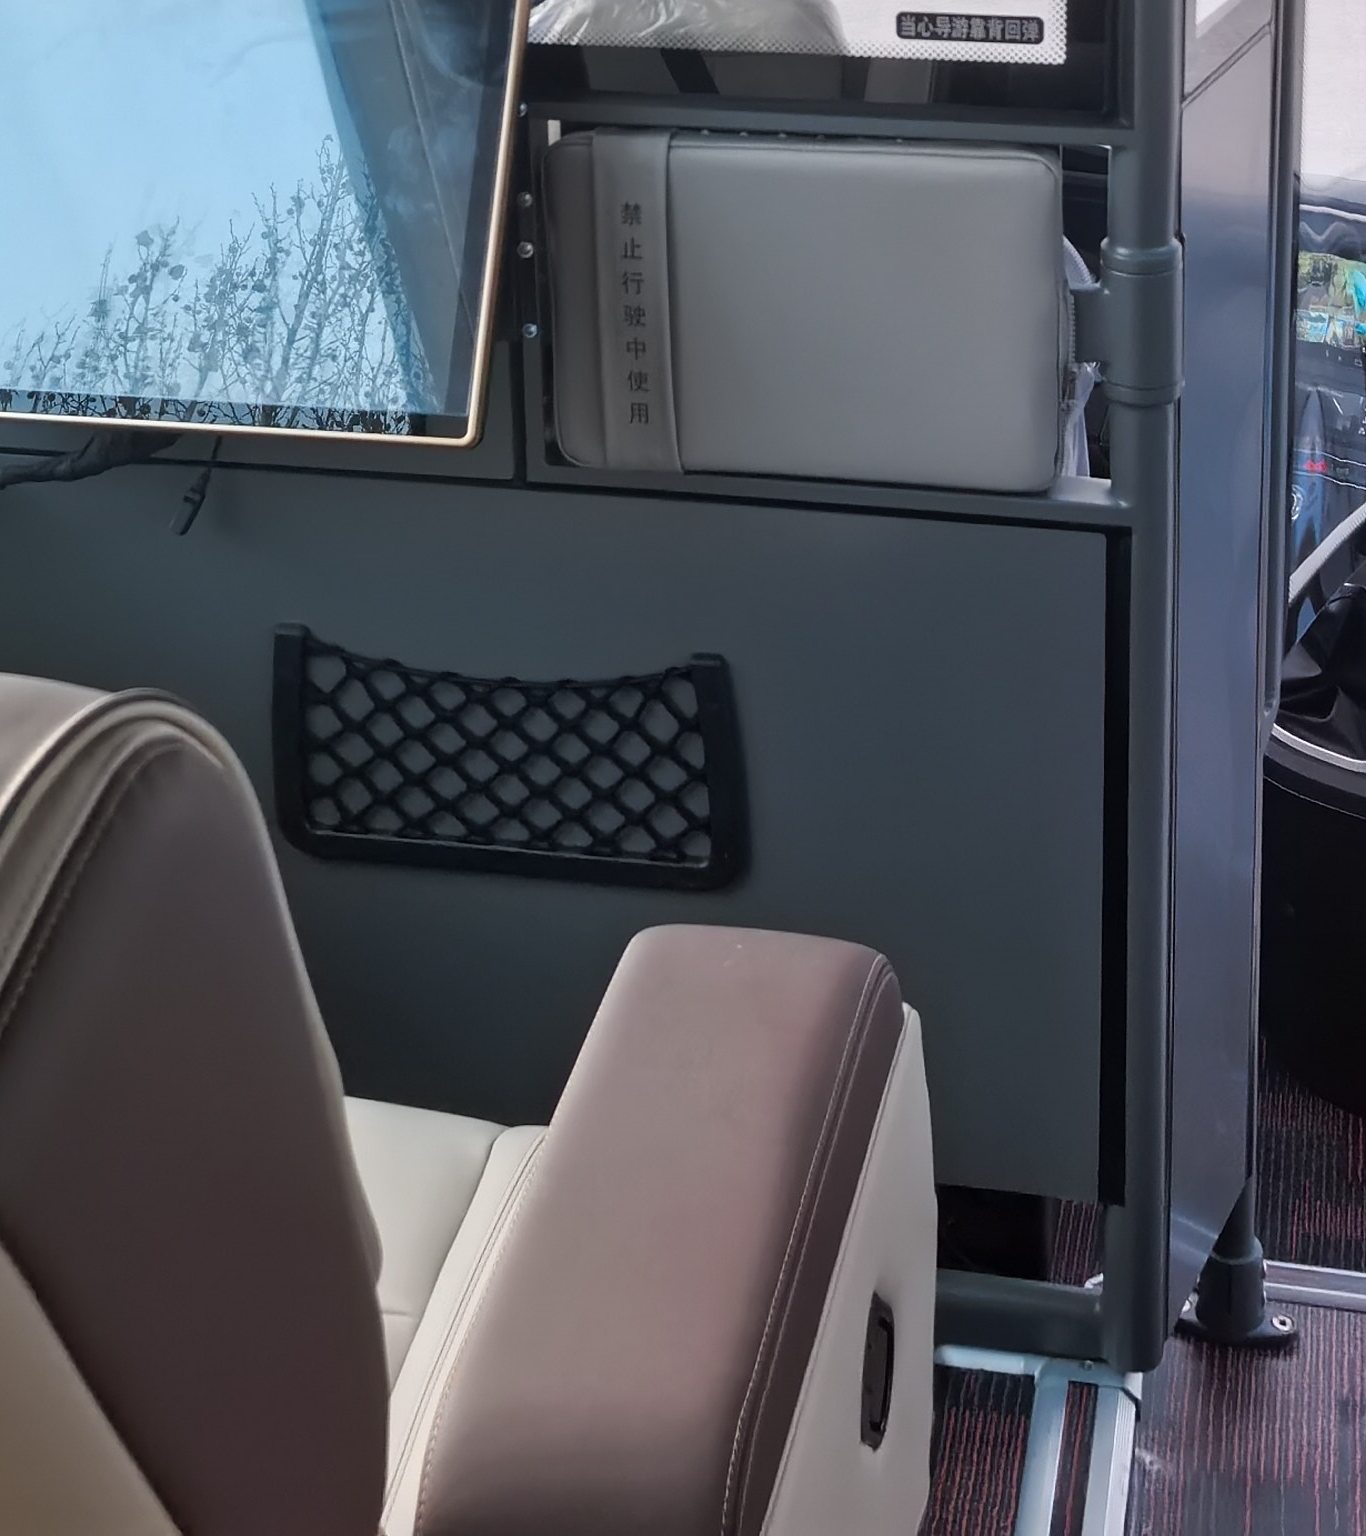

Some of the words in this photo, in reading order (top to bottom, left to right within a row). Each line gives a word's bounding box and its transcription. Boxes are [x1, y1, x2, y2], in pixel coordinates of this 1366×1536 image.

[900, 14, 1040, 42] 当心导游靠背回弹
[619, 201, 651, 425] 禁止行驶中使用
